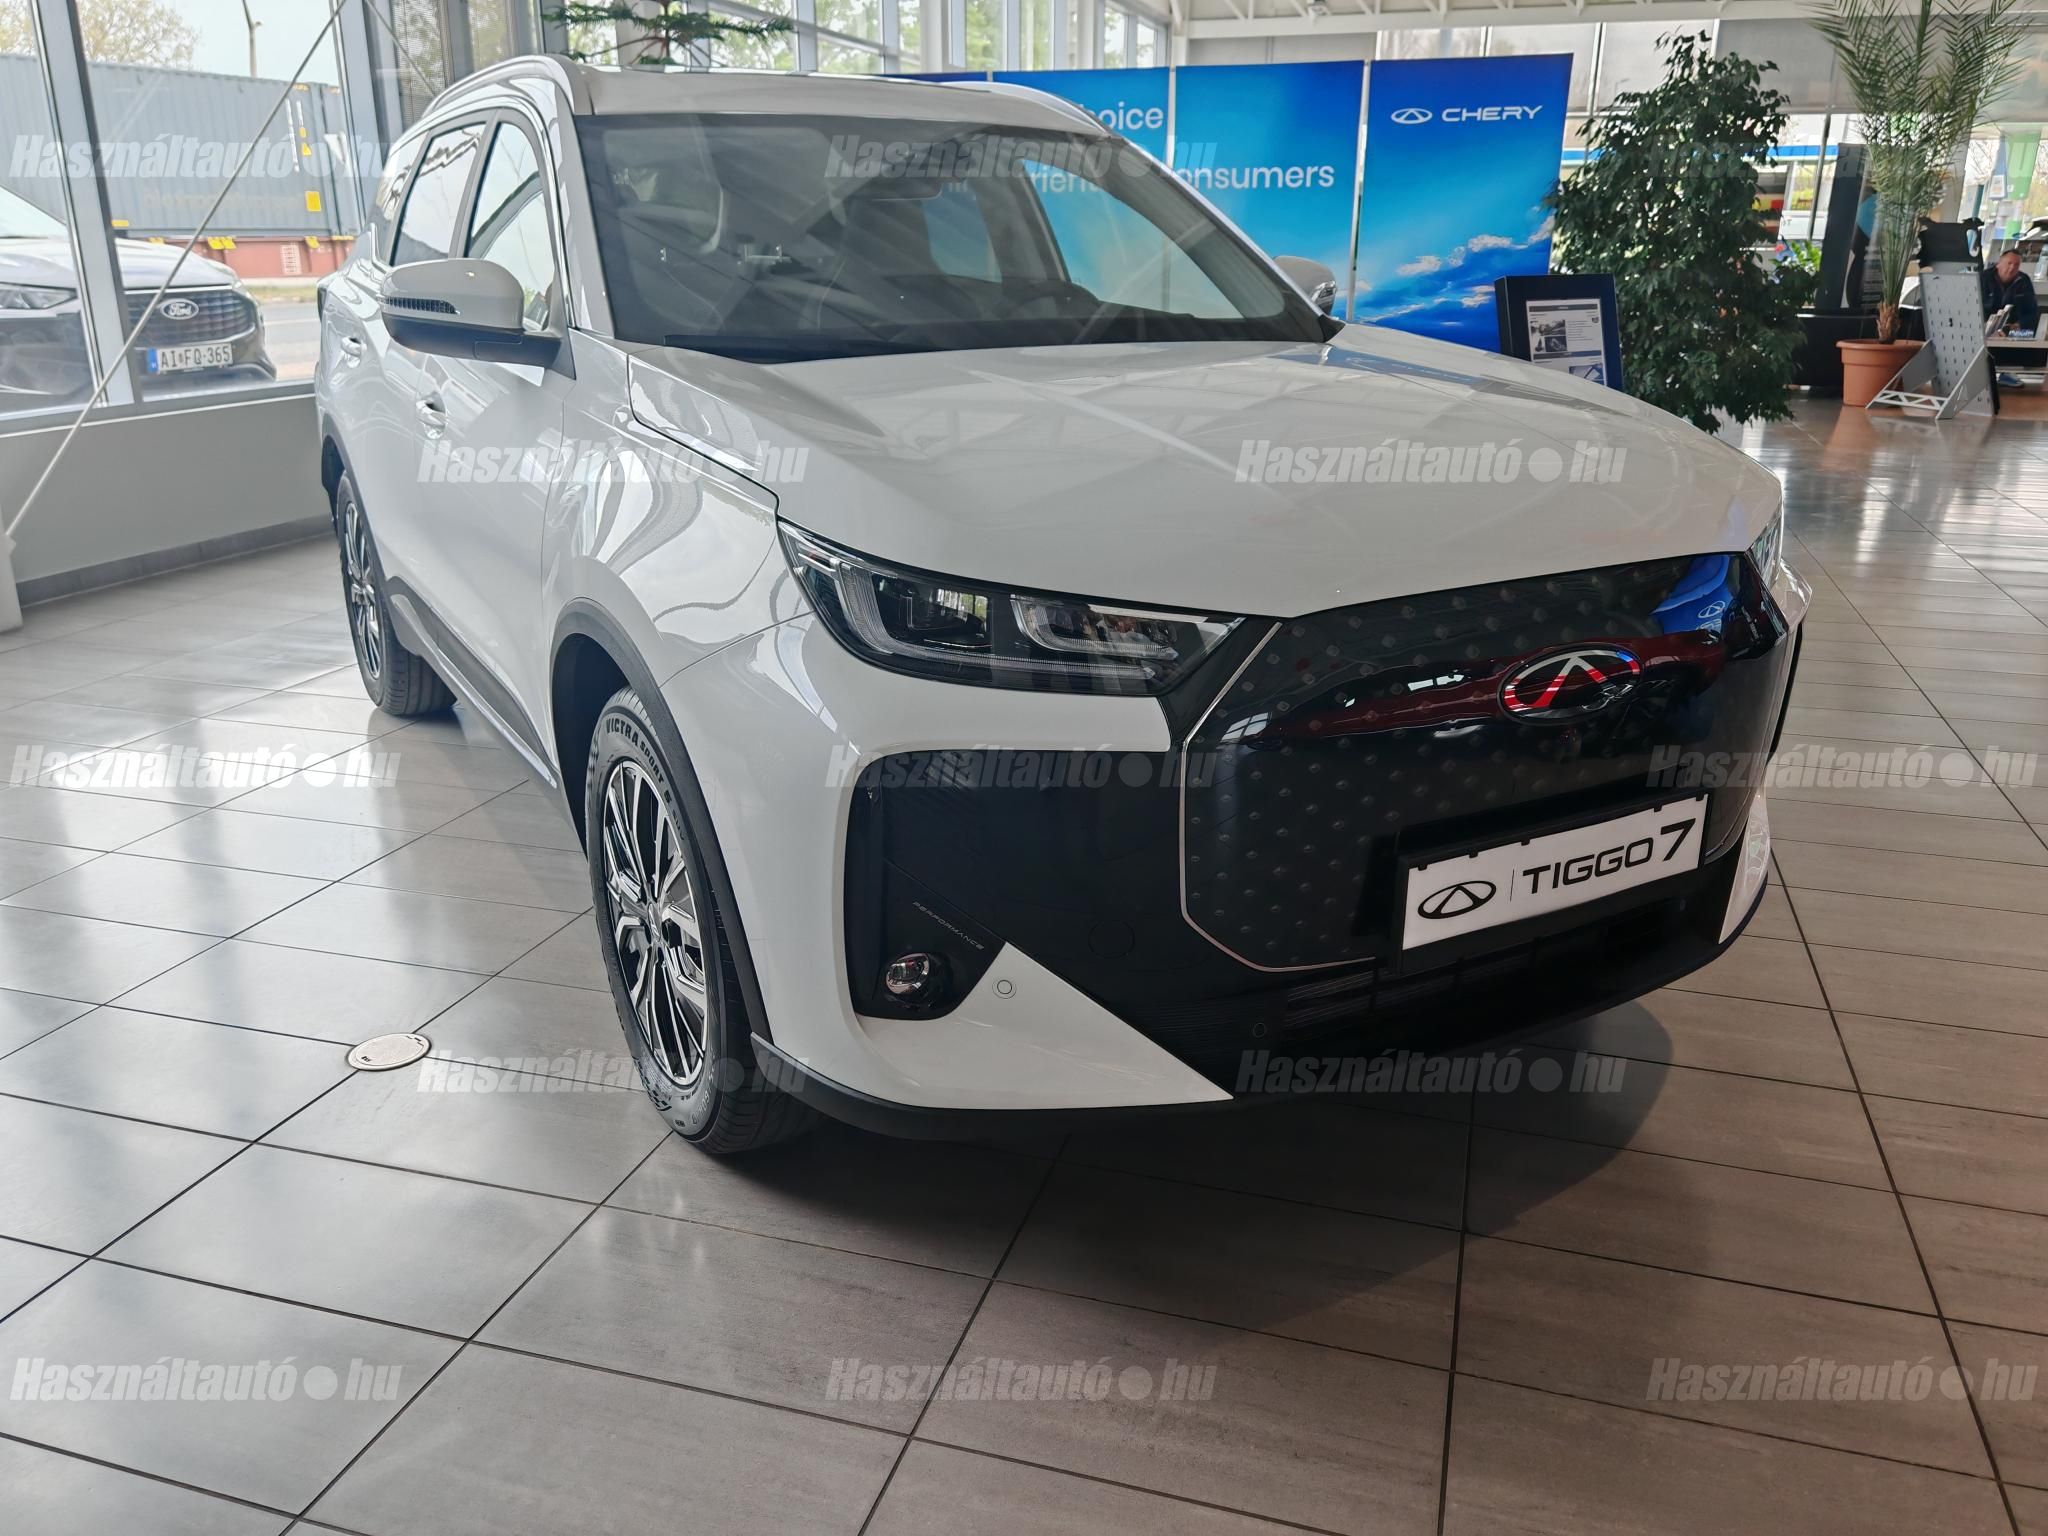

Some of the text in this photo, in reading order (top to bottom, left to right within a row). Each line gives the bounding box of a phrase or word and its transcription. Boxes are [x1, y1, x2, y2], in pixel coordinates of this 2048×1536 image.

[1441, 105, 1543, 122] CHERY
[1174, 163, 1335, 190] onsumers
[167, 302, 192, 316] Ford
[606, 718, 639, 747] VICTRA
[639, 741, 665, 783] SPORT
[1522, 818, 1697, 894] TIGGO 7
[912, 901, 985, 950] PERFORMANCE
